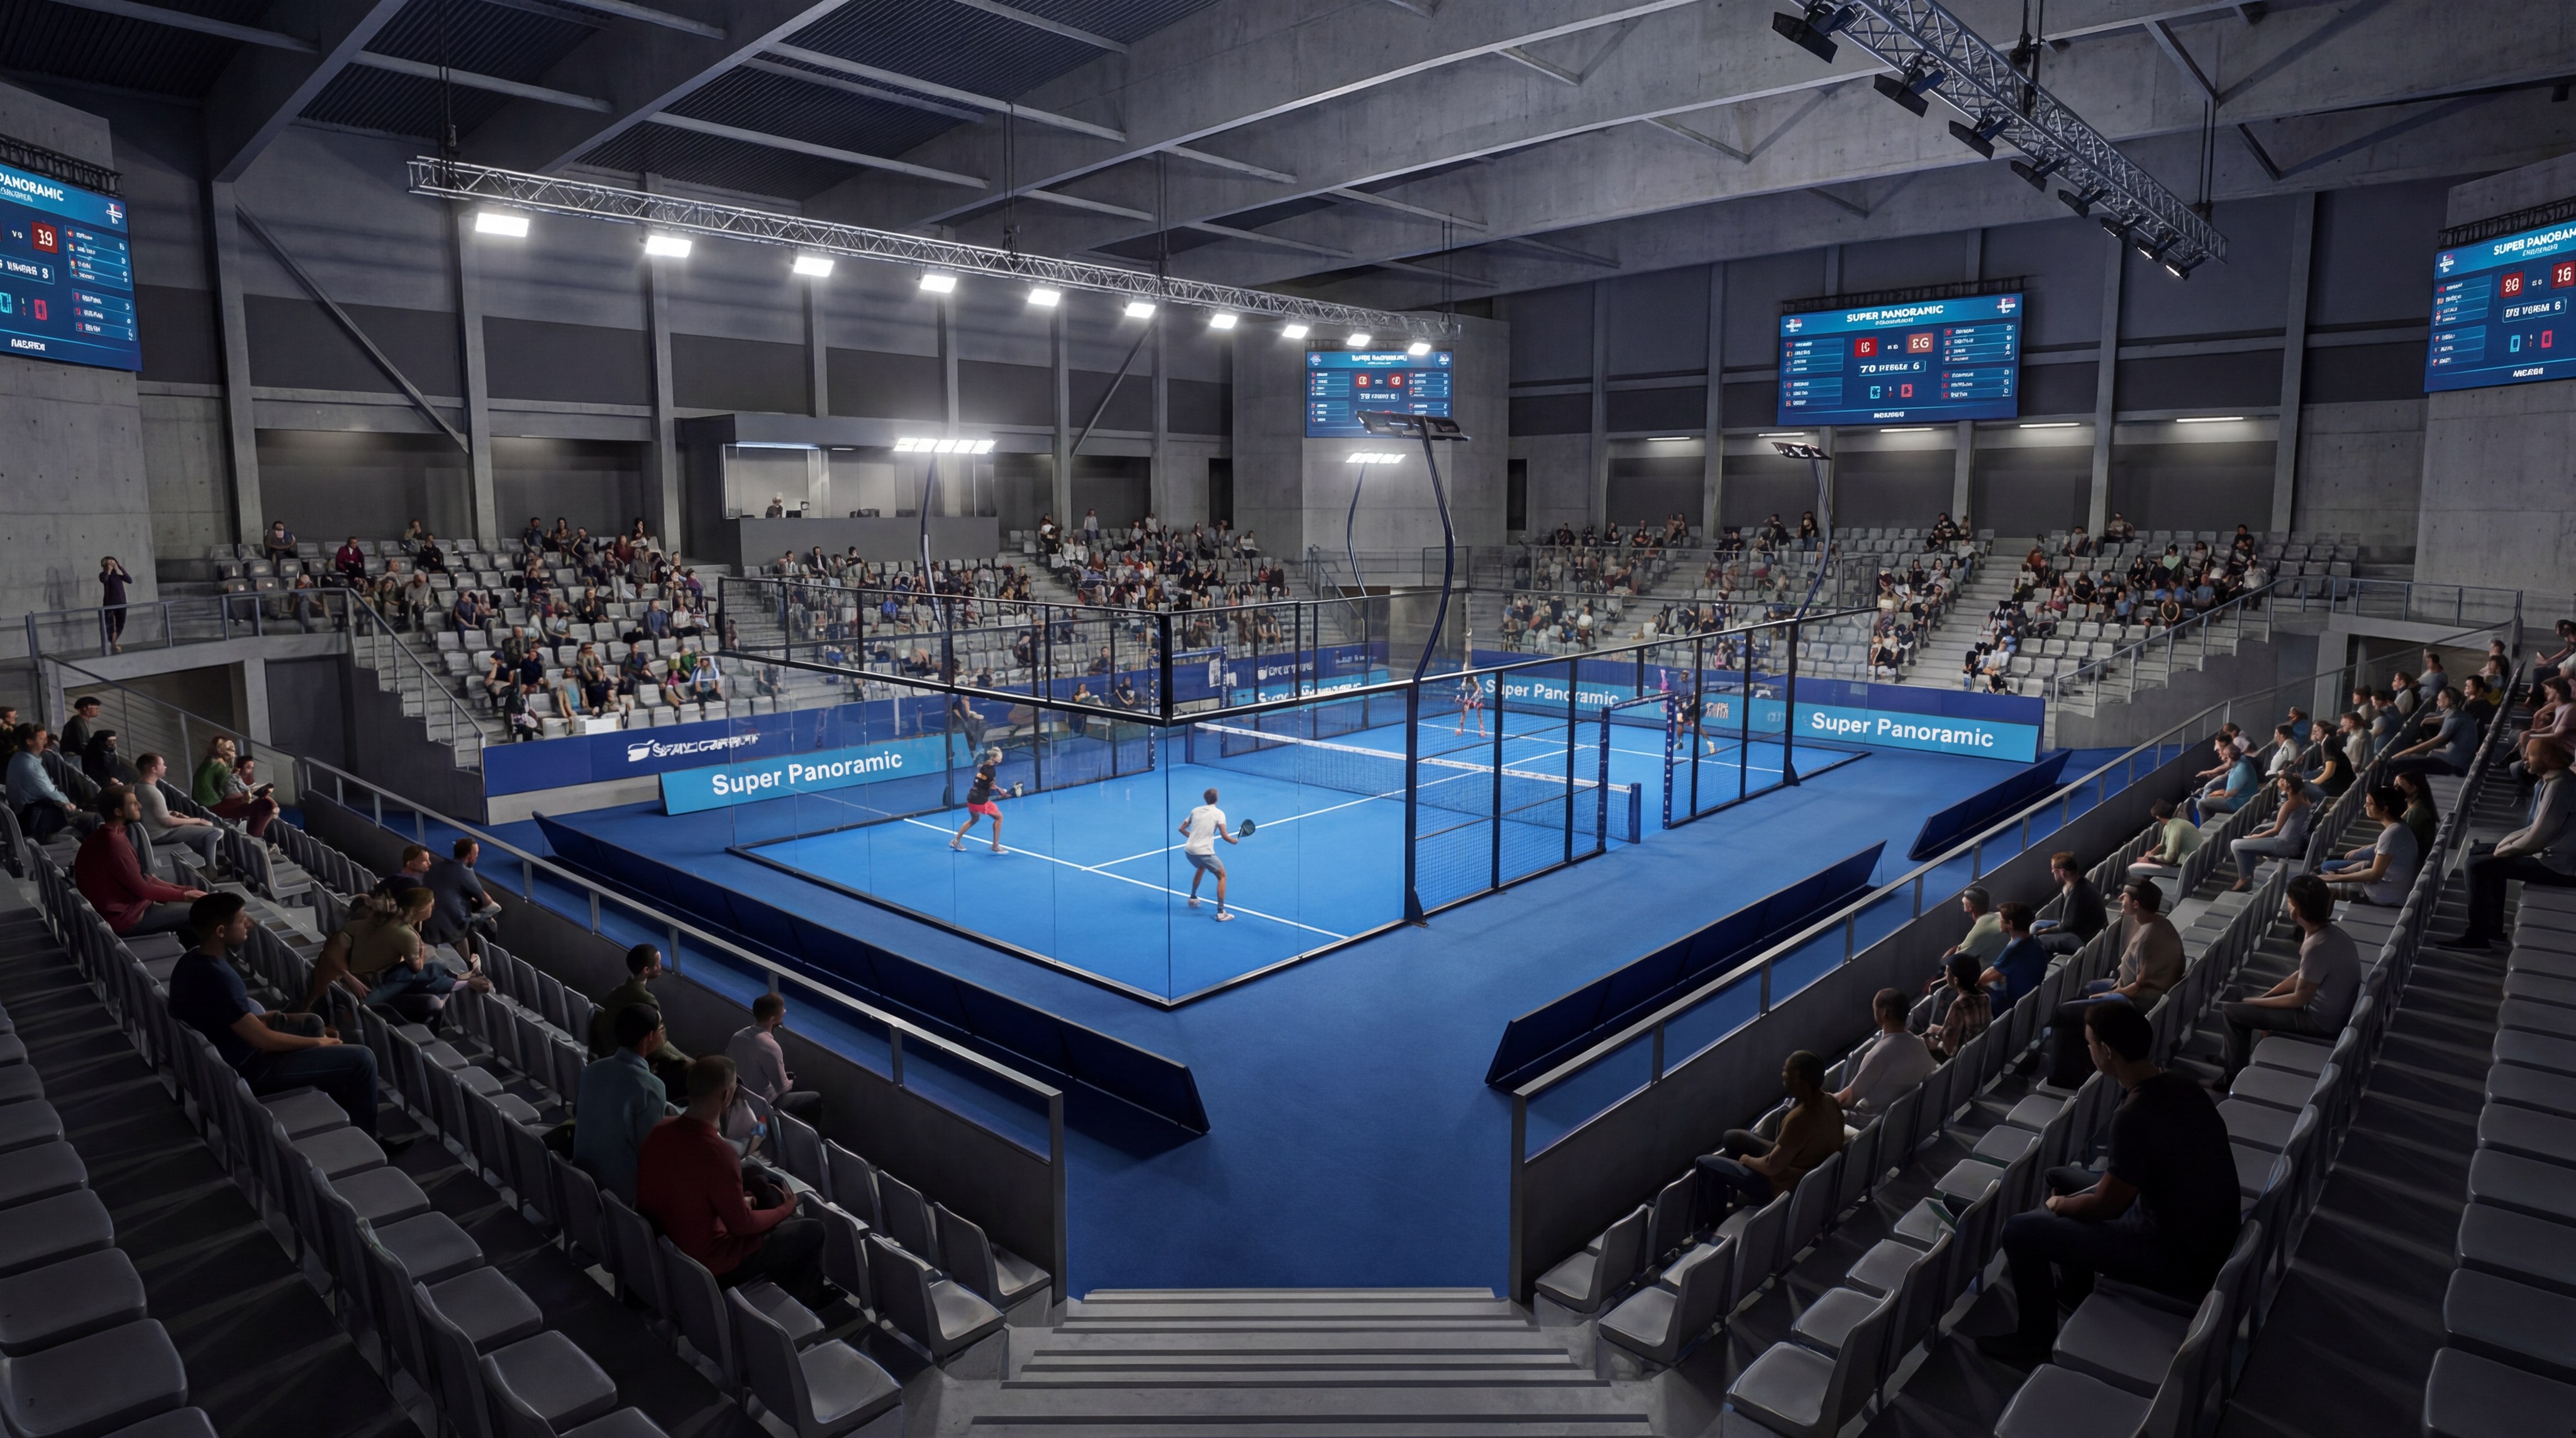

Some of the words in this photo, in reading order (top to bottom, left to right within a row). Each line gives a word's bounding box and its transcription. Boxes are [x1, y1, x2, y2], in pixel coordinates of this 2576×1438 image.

[1846, 311, 1879, 323] SUPER
[1860, 365, 1876, 373] 70
[1812, 712, 1870, 735] Super
[1877, 718, 1994, 747] Panoramic
[712, 774, 781, 795] Super
[788, 751, 902, 784] Panoramic
